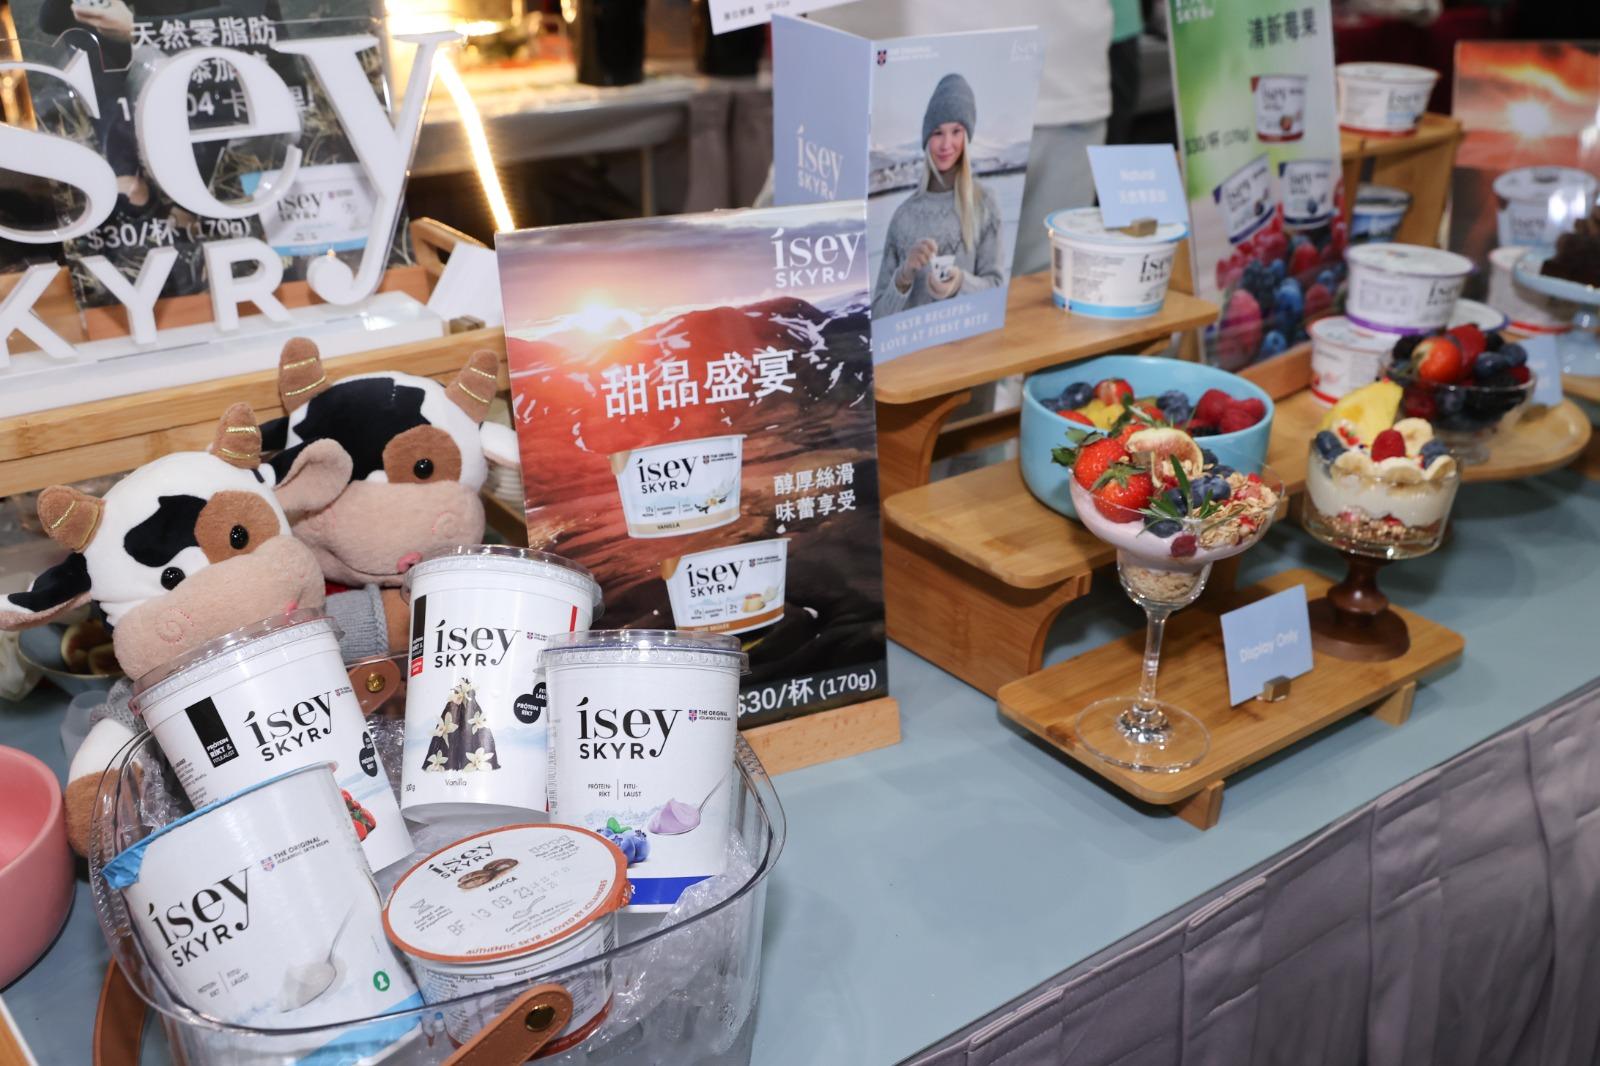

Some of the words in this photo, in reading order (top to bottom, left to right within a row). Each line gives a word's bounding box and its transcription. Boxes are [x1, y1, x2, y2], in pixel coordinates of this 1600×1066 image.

[130, 15, 277, 51] 天然零脂肪
[770, 228, 865, 280] ísey
[775, 267, 836, 289] SKYR
[601, 346, 798, 418] 甜品盛宴
[636, 455, 697, 488] ísey
[641, 481, 679, 495] SKYR
[774, 463, 855, 496] 醇厚絲滑
[775, 489, 857, 523] 味蕾享受
[686, 560, 744, 591] ísey
[690, 583, 726, 598] SKYR
[433, 619, 522, 667] ísey
[434, 653, 487, 669] SKYR
[819, 669, 878, 700] (170g)
[243, 691, 334, 749] ísey
[576, 696, 683, 757] ísey
[261, 728, 322, 762] SKYR
[580, 742, 645, 760] SKYR
[273, 849, 287, 860] THE
[288, 836, 321, 853] ORIGINAL
[427, 841, 494, 875] ísey
[440, 853, 485, 880] SKYR
[487, 875, 518, 893] MOCCA
[148, 867, 252, 949] ísey
[172, 924, 234, 968] SKYR
